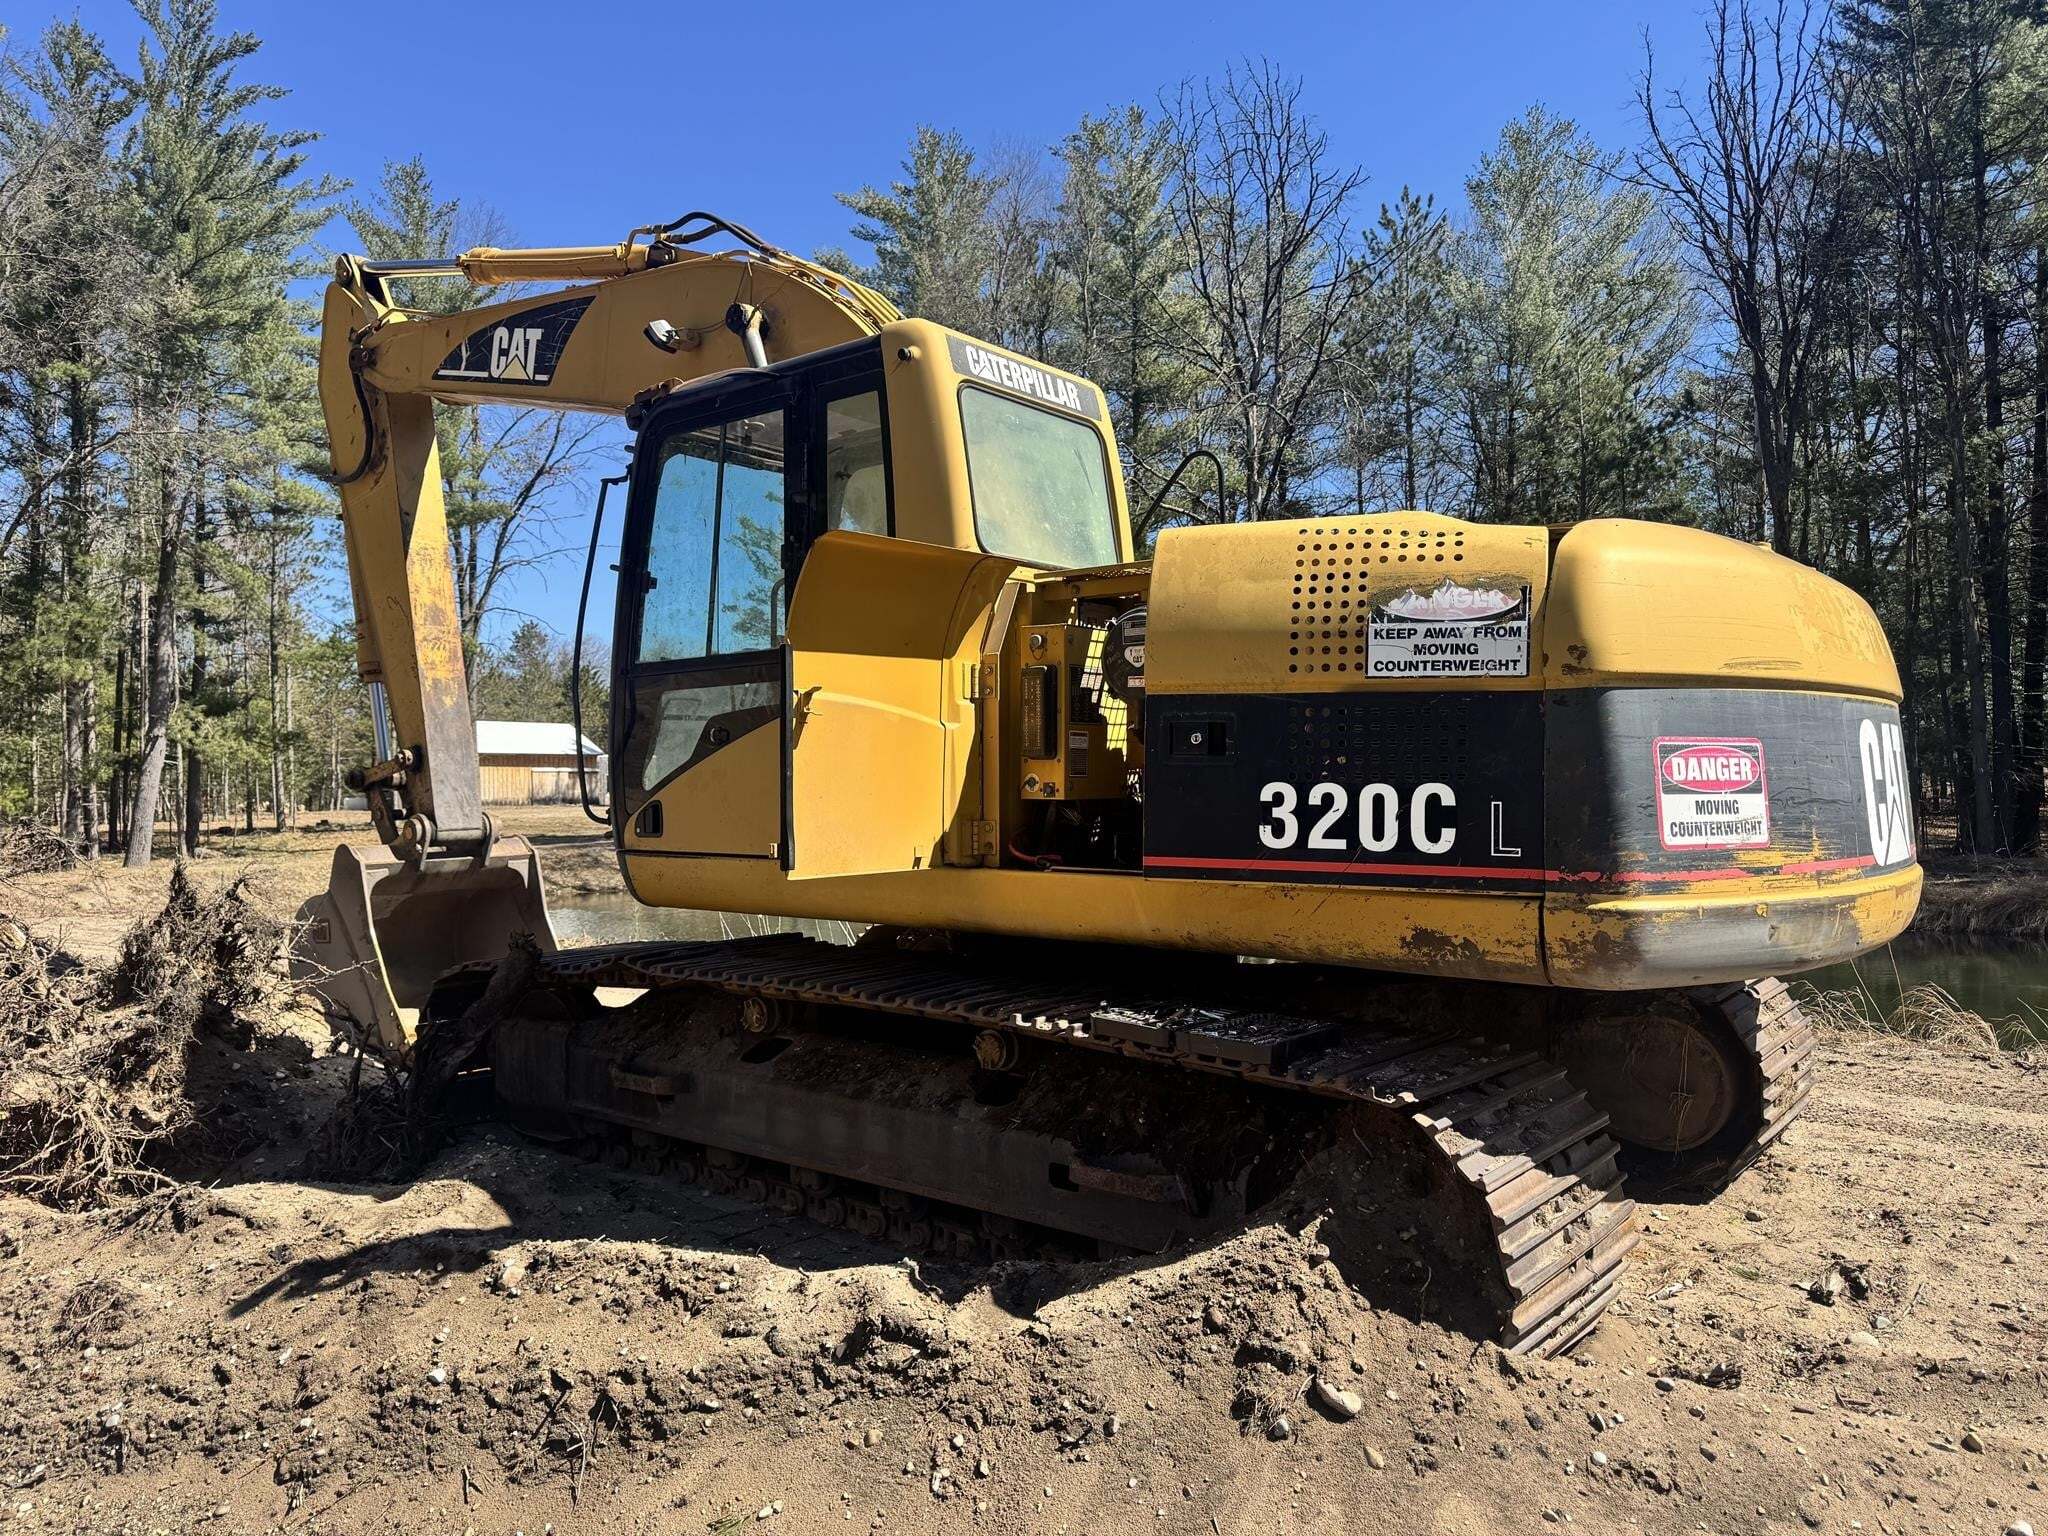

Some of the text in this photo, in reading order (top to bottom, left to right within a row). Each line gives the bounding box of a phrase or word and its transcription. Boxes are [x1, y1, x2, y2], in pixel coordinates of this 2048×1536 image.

[490, 326, 544, 380] CAT
[965, 345, 1082, 411] CATERPILLAR
[1373, 626, 1522, 640] KEEP AWAY FROM
[1413, 643, 1479, 656] MOVING
[1373, 659, 1521, 672] COUNTERWEIGHT
[1671, 757, 1752, 781] DANGER
[1859, 719, 1912, 867] CAT
[1695, 800, 1740, 815] MOVING
[1258, 782, 1522, 857] 320C L
[1670, 820, 1762, 838] COUNTERWEIGHT
